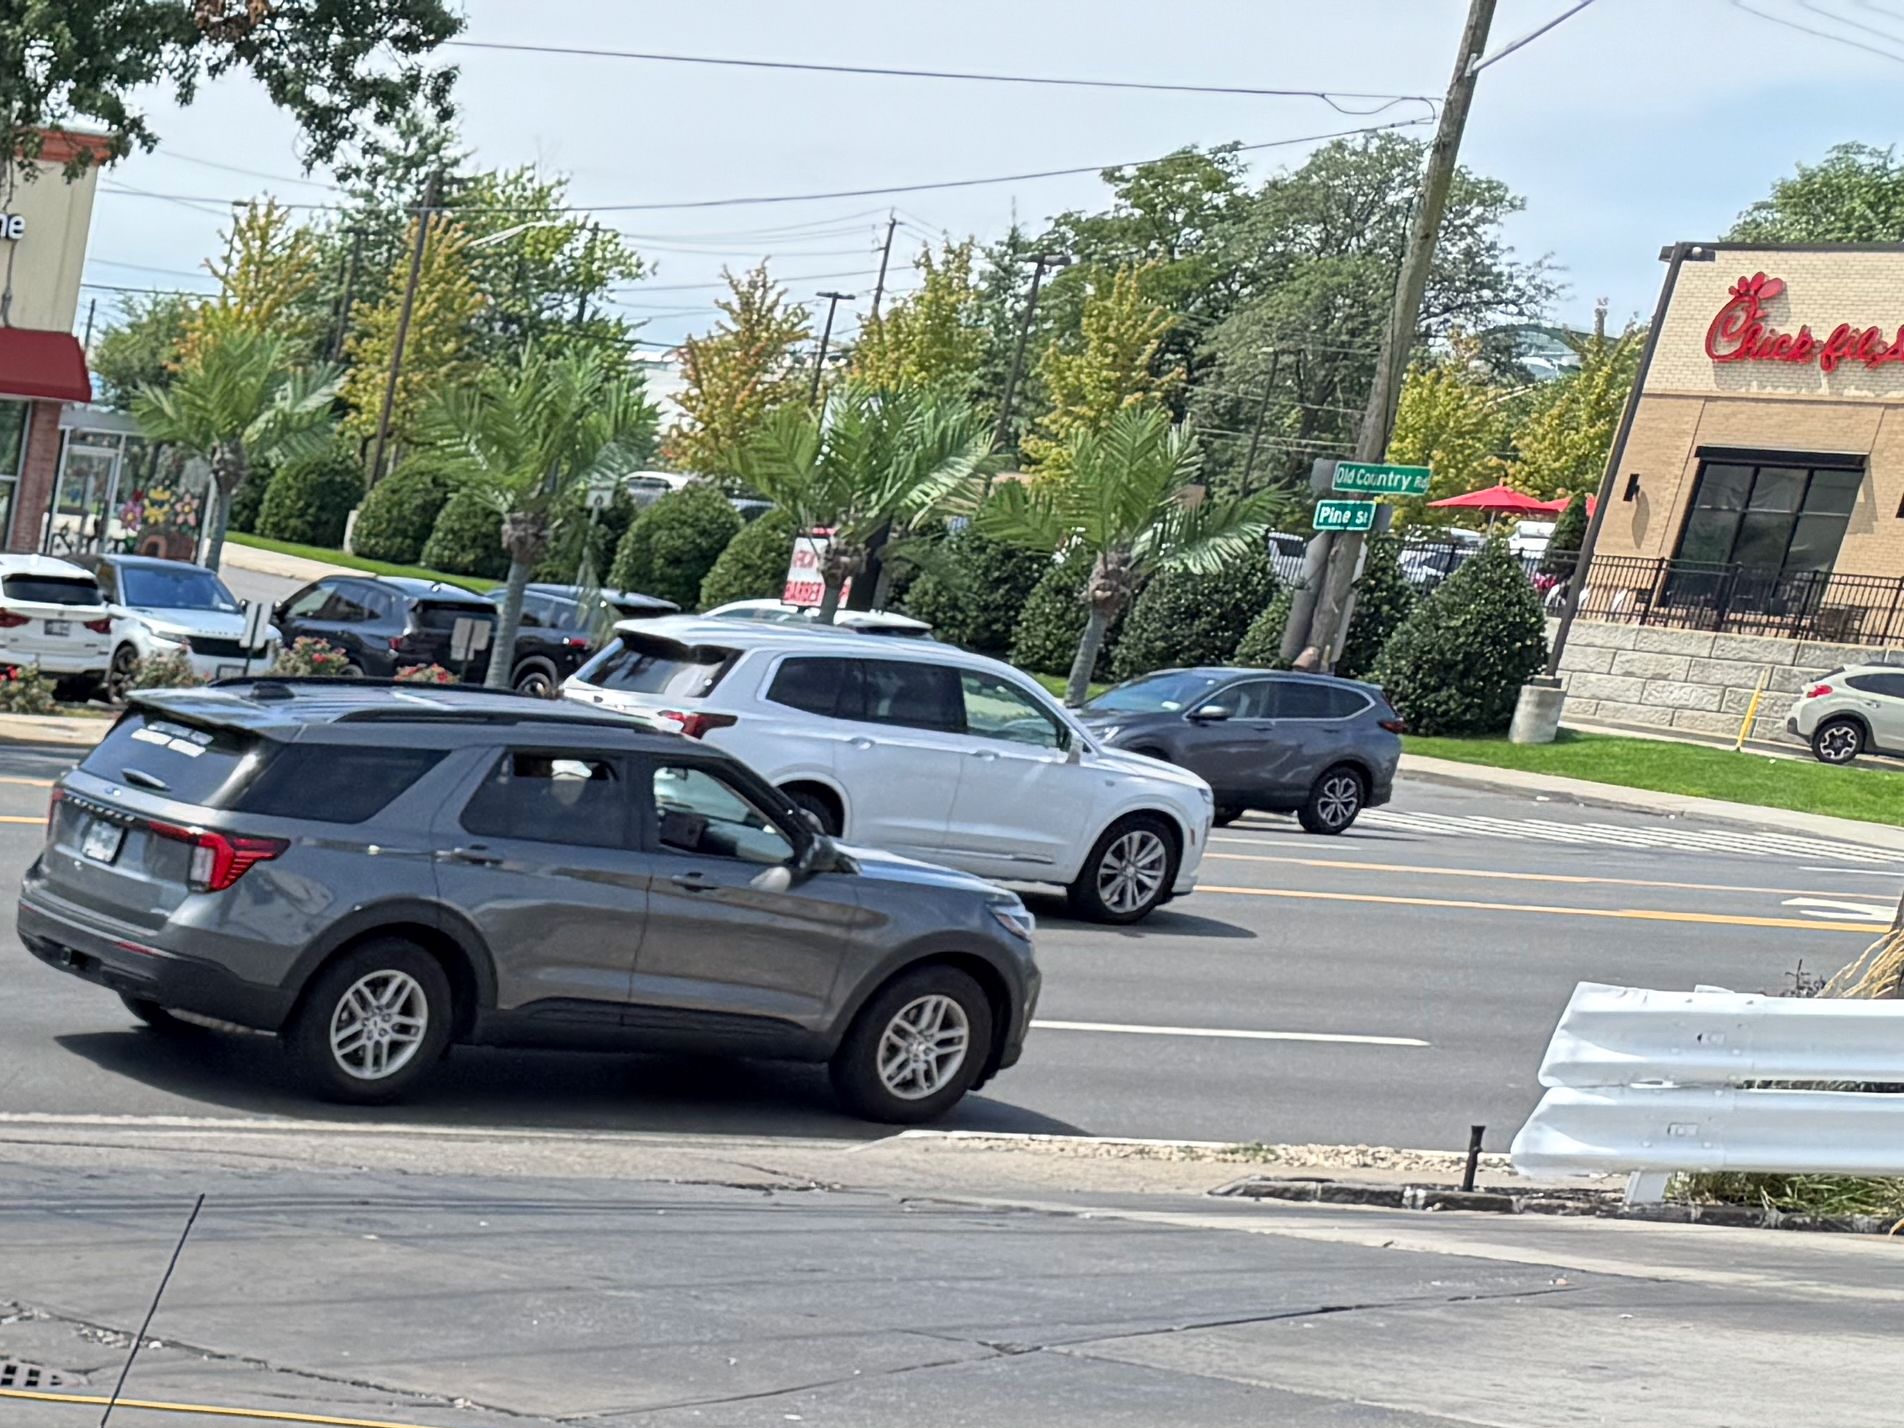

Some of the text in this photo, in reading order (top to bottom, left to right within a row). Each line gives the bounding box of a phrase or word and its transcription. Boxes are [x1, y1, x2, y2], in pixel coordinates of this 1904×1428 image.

[1335, 466, 1355, 484] Old
[1356, 468, 1412, 491] Country
[1318, 506, 1352, 524] Pine
